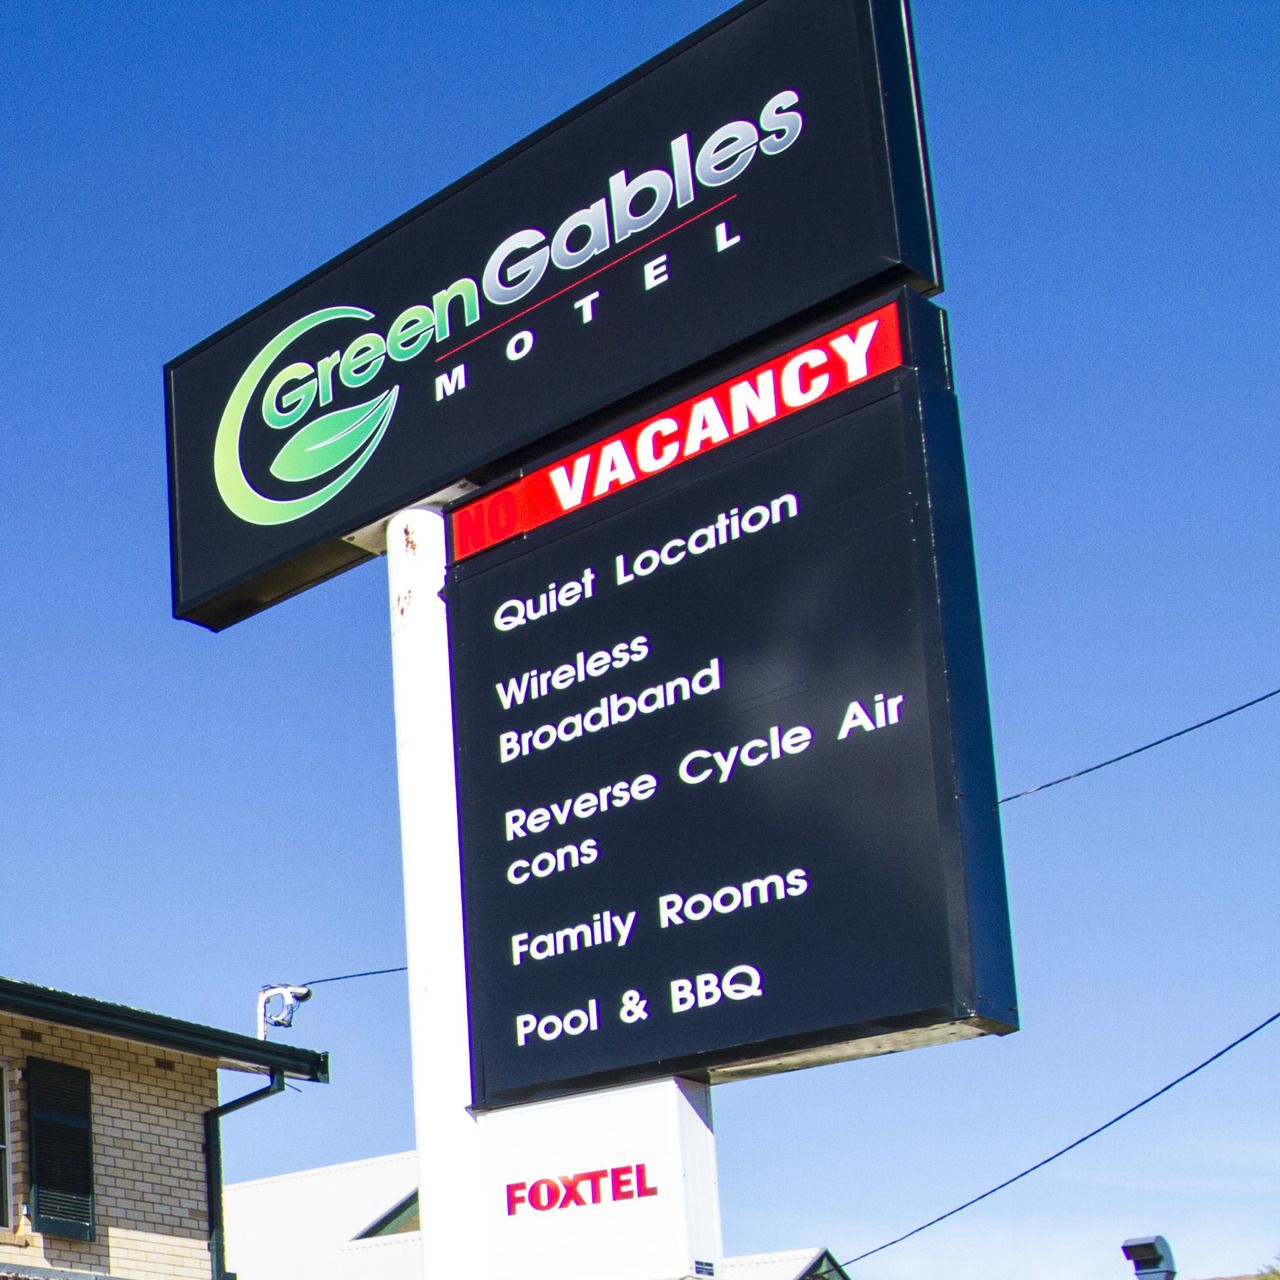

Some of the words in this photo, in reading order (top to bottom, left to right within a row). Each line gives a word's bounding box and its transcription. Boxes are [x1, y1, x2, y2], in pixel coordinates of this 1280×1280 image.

[434, 222, 741, 402] MOTEL
[457, 491, 518, 556] NO
[548, 319, 879, 511] VACANCY
[493, 567, 595, 632] Quiet
[615, 493, 798, 586] Location
[495, 635, 649, 710] Wireless
[499, 657, 721, 764] Broadband
[504, 773, 657, 842] Reverse
[678, 725, 812, 785] Cycle
[836, 693, 904, 741] Air
[506, 838, 598, 885] cons
[511, 910, 636, 966] Family
[658, 868, 808, 929] Rooms
[516, 998, 598, 1047] Pool
[619, 989, 649, 1024] &
[670, 964, 763, 1014] BBQ
[506, 1163, 658, 1216] FOXTEL
